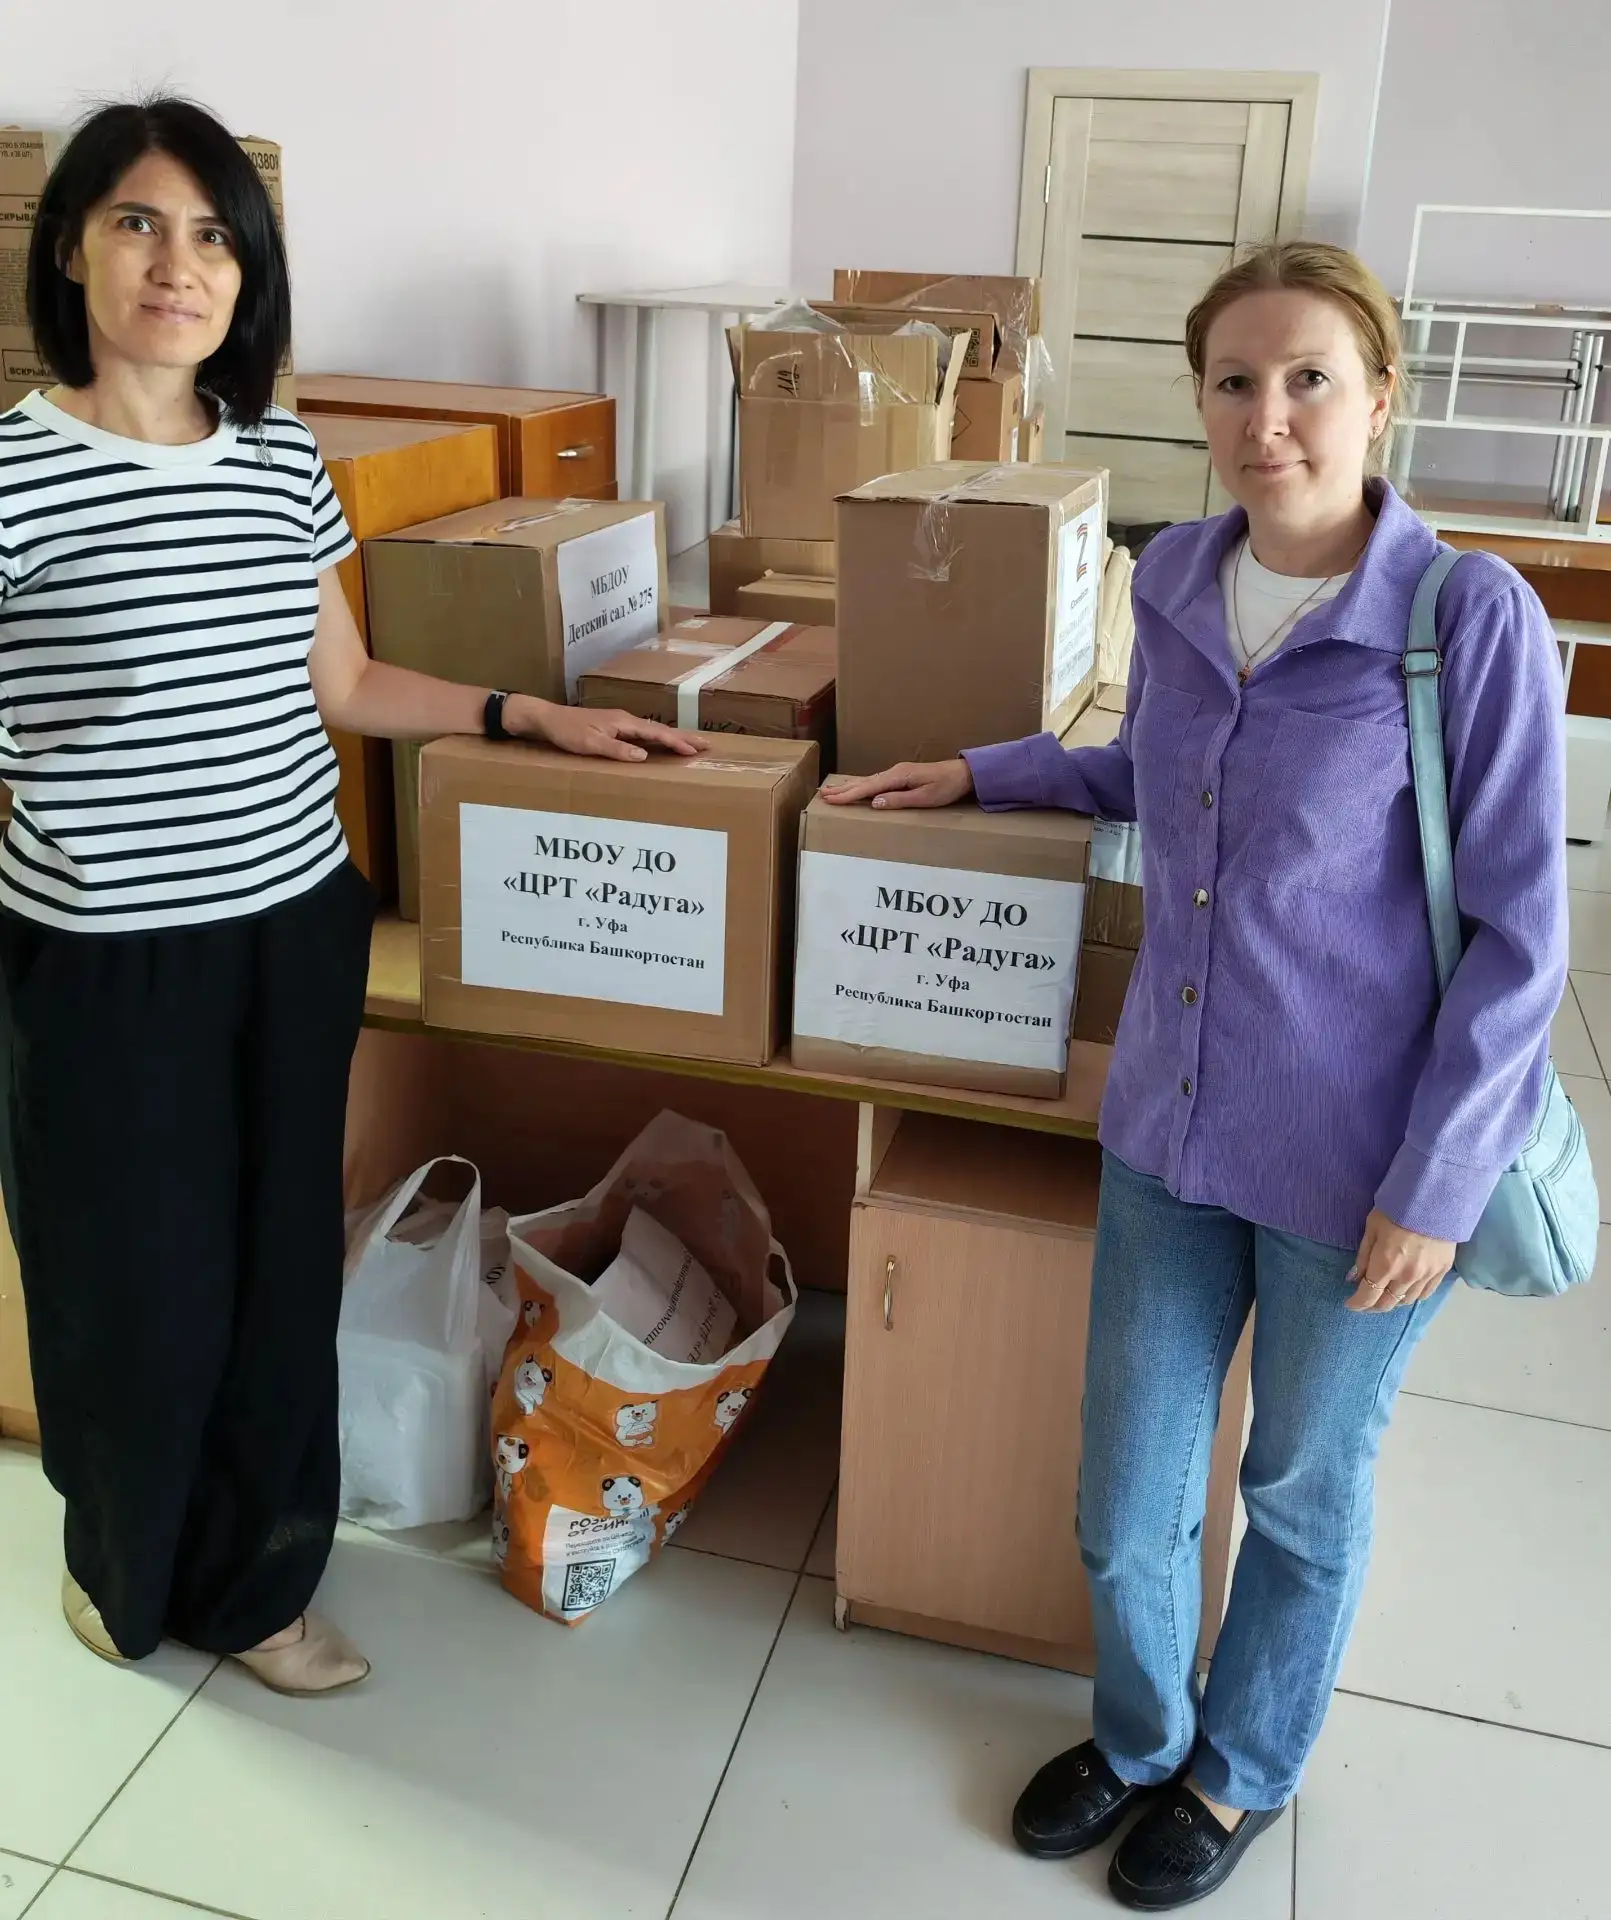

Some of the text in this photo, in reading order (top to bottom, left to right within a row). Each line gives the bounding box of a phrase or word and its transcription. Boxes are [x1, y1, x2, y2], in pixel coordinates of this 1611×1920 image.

[590, 565, 630, 599] МБДОУ
[568, 587, 653, 646] Детский сад № 275
[534, 834, 677, 876] МБОУ ДО
[503, 871, 705, 916] «ЦРТ «Радуга»
[876, 886, 1028, 929] МБОУ ДО
[578, 916, 628, 934] г. Уфа
[501, 930, 705, 969] Республика Башкортостан
[841, 924, 1056, 971] «ЦРТ «Радуга»
[916, 973, 970, 993] г. Уфа
[835, 984, 1052, 1028] Республика Башкортостан
[568, 1529, 587, 1538] ОТ
